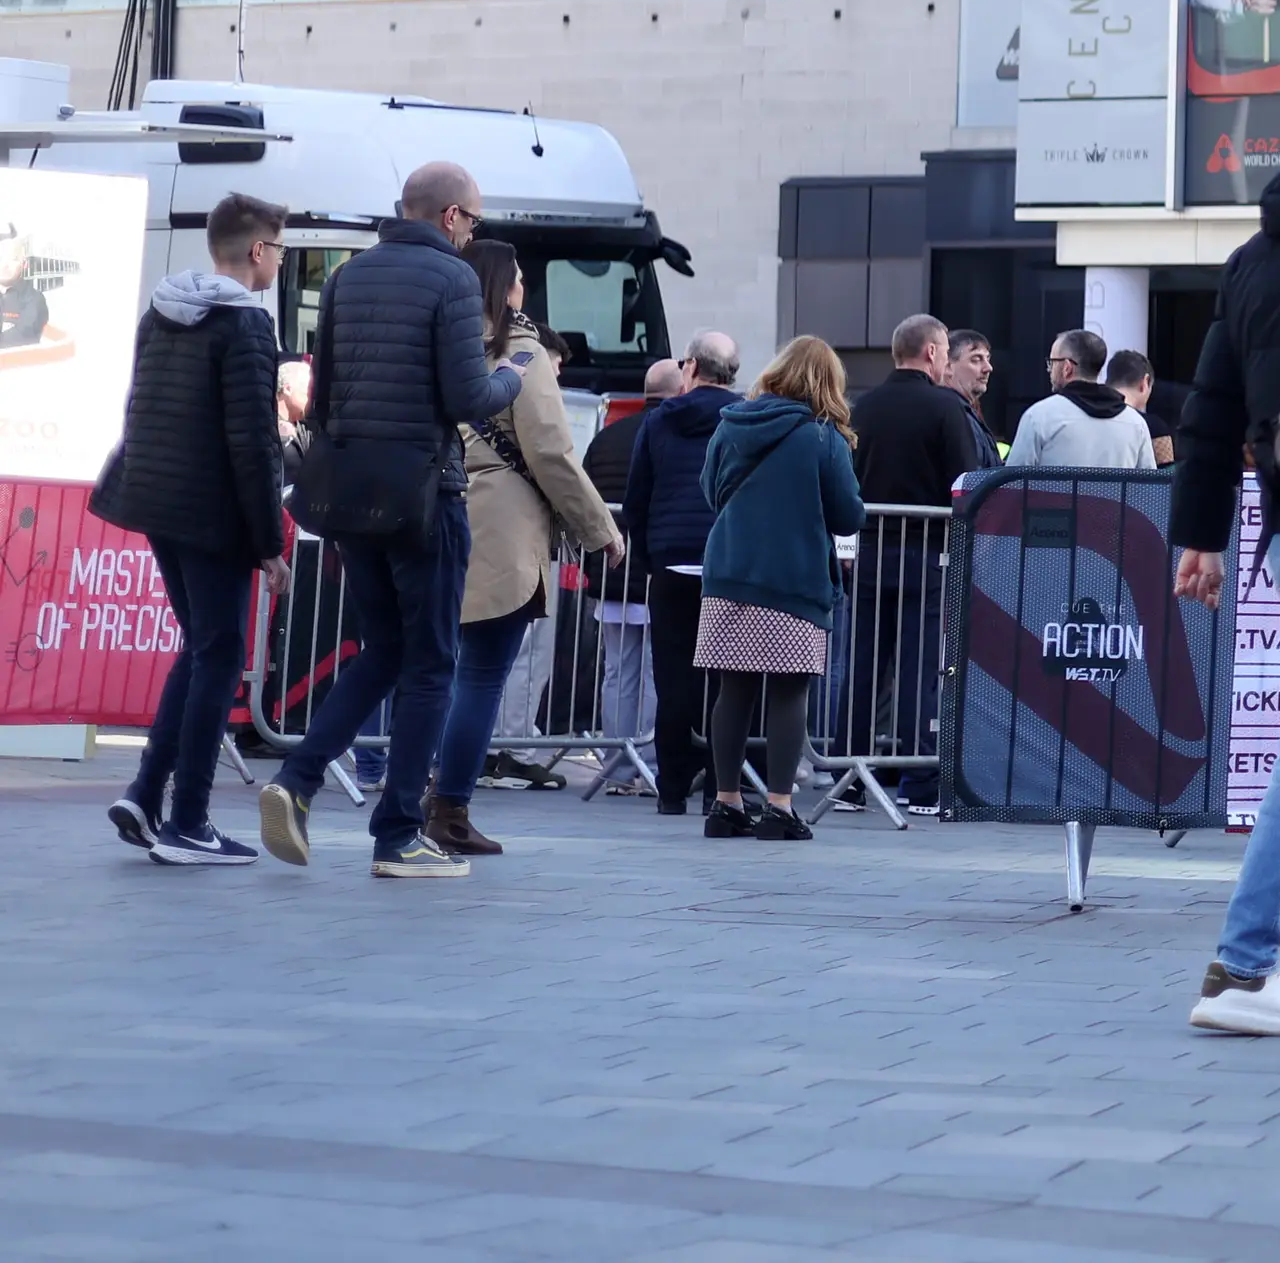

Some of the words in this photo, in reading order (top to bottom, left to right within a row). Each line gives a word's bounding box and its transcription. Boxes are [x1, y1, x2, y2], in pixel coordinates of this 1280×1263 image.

[1112, 147, 1150, 161] CROWN
[69, 548, 168, 598] MASTE
[36, 602, 77, 650] OF
[80, 603, 184, 653] PRECISI
[1043, 623, 1144, 660] ACTION
[1066, 667, 1121, 681] WST.TV
